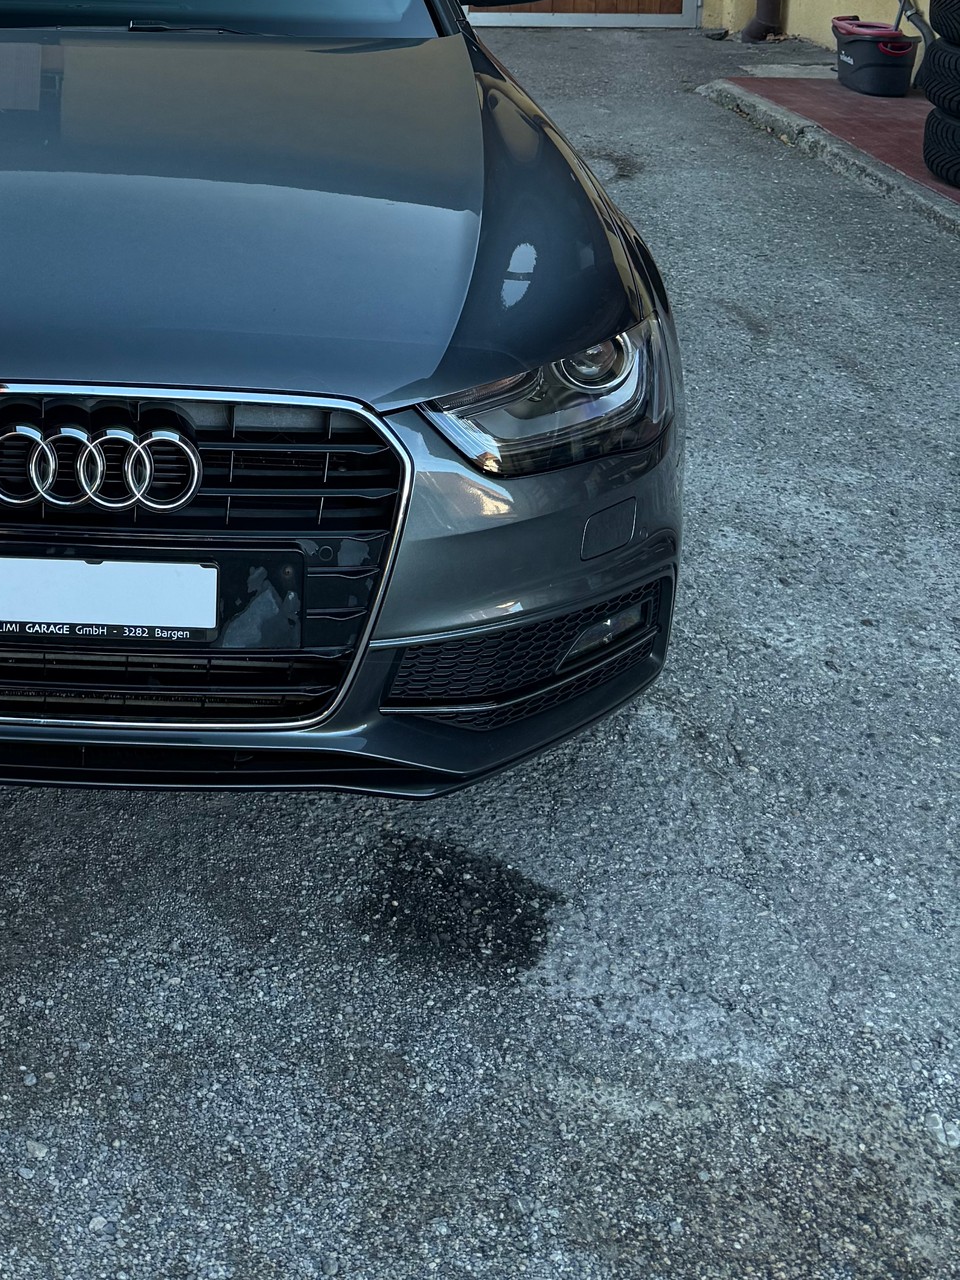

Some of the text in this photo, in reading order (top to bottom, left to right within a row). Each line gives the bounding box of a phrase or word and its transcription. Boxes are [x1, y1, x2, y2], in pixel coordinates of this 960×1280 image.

[25, 623, 70, 634] GARAGE
[75, 625, 107, 635] GmbH
[122, 626, 149, 637] 3282
[154, 628, 190, 640] Bargen
